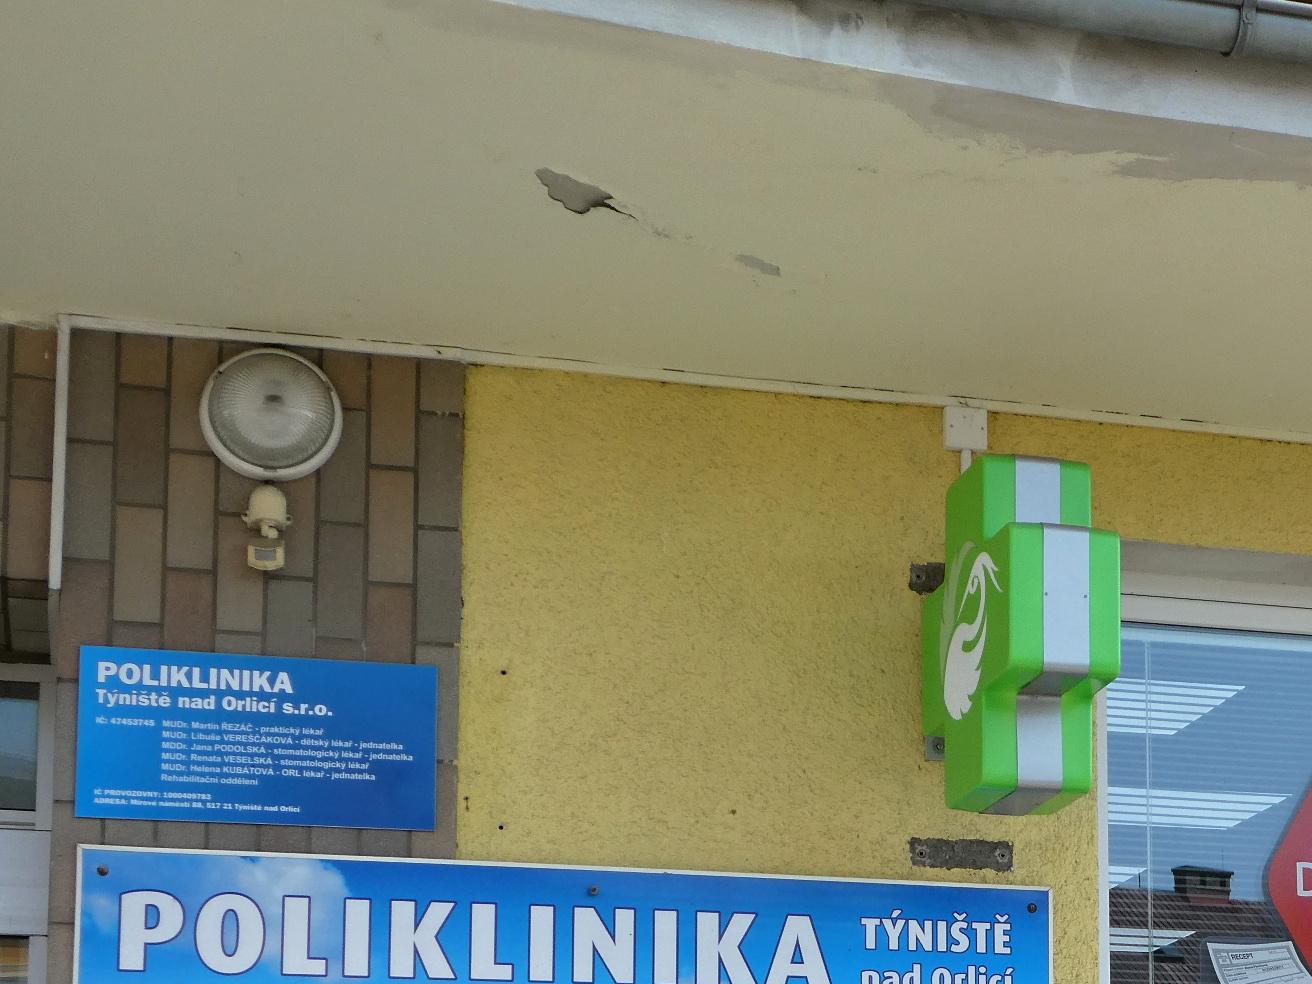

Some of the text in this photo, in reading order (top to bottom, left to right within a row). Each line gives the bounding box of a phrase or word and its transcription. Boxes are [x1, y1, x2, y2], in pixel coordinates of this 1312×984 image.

[97, 661, 293, 693] POLIKLINIKA
[96, 688, 332, 716] Týniště nad Orlicí s.r.o.
[162, 720, 188, 728] MUDr.
[191, 721, 219, 730] Martin
[221, 722, 252, 732] ŘEZÁČ
[260, 725, 300, 738] praktický
[302, 727, 324, 736] lékař
[861, 909, 1013, 957] TÝNIŠTĚ
